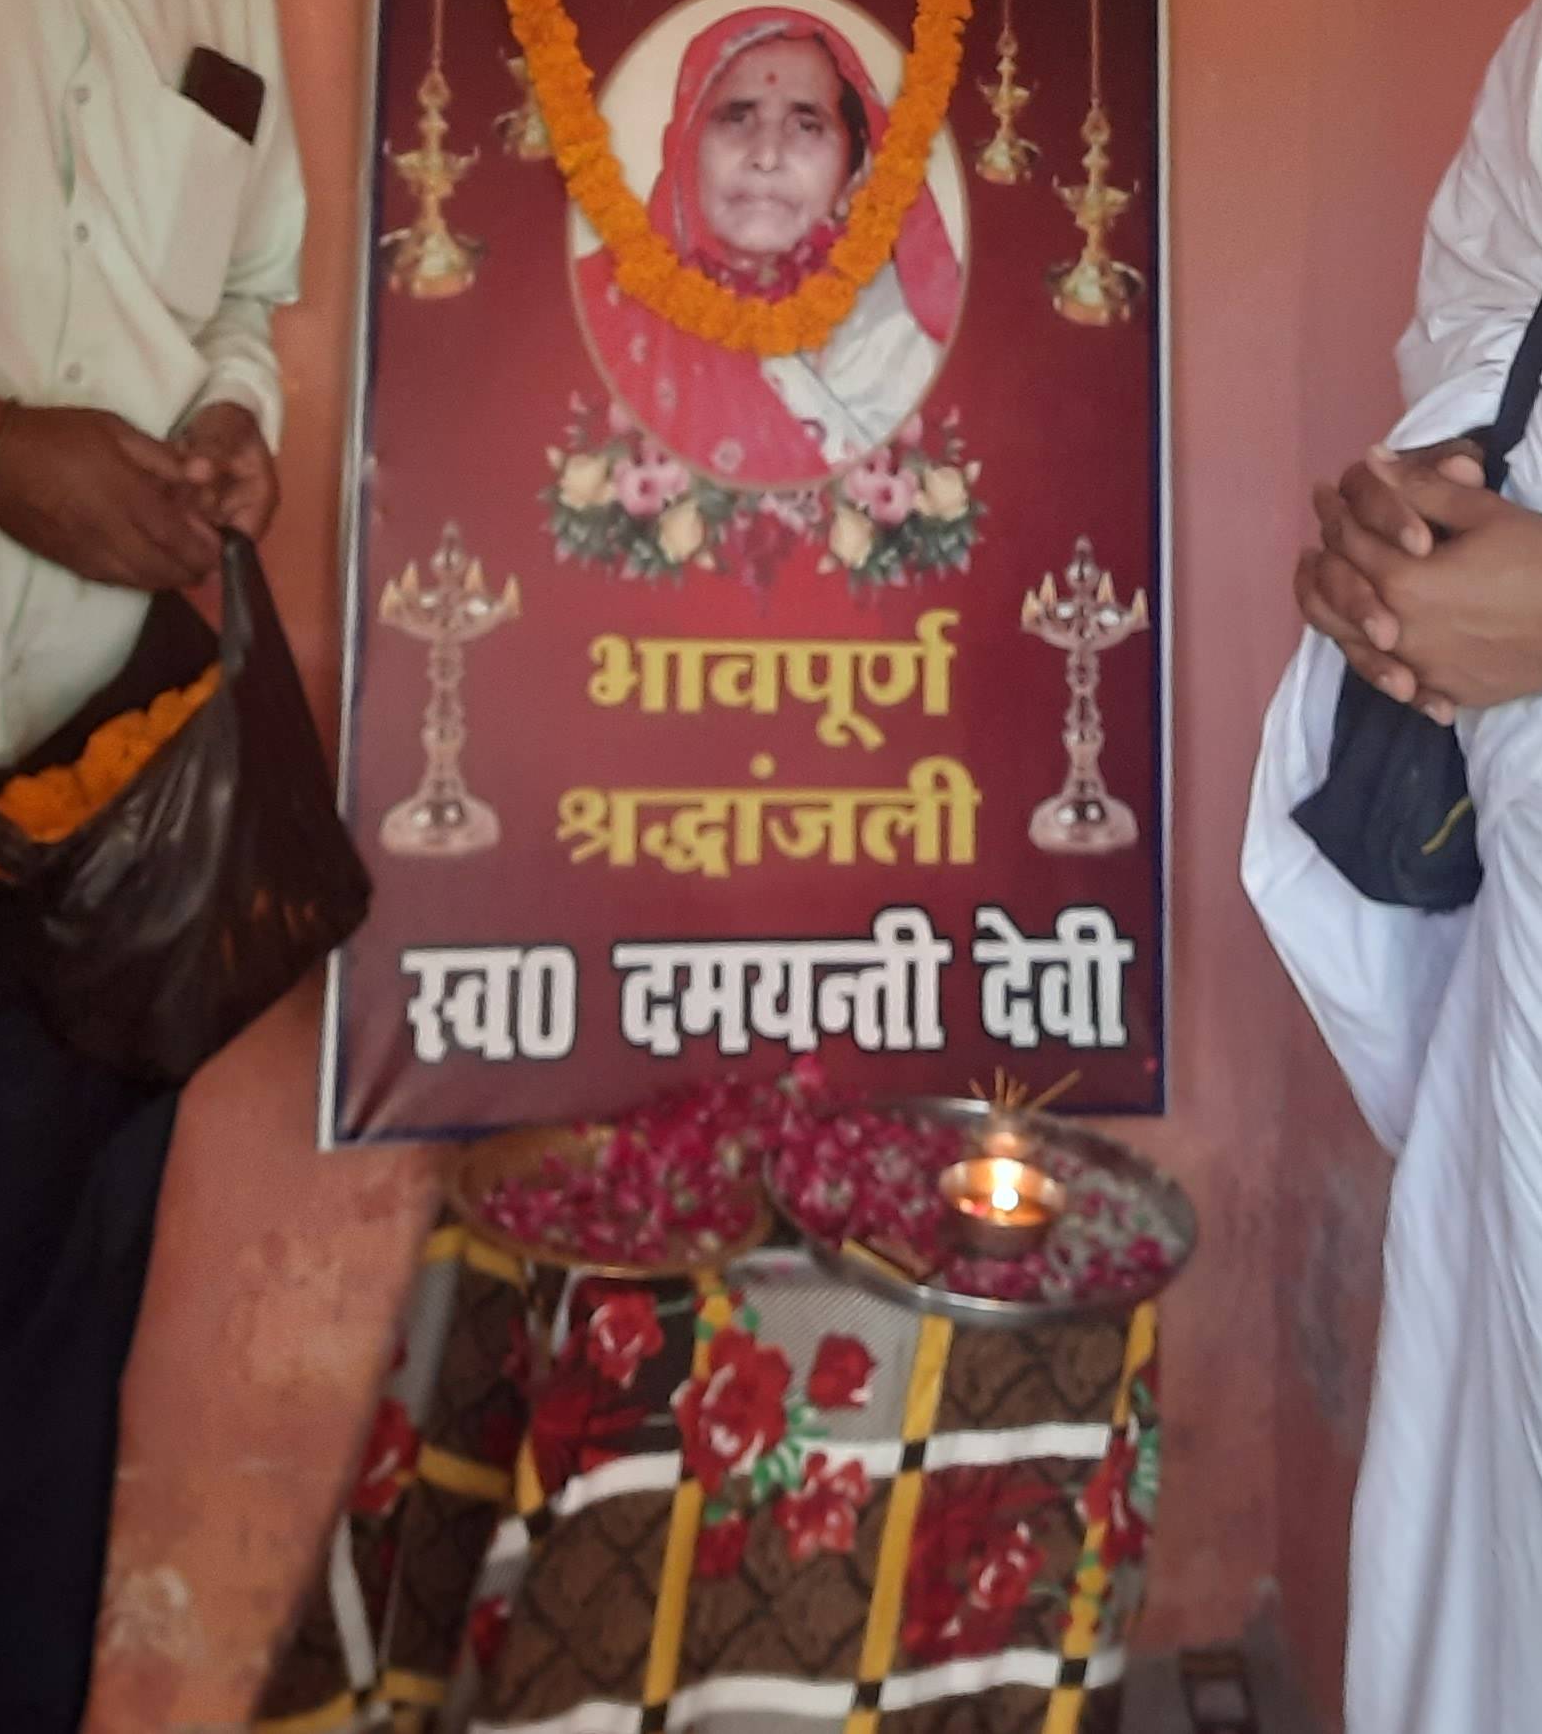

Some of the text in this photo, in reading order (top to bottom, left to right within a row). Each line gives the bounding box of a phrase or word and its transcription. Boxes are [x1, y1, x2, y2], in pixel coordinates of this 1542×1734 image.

[589, 610, 962, 748] भावपूर्ण
[557, 754, 980, 877] श्रद्धांजली
[612, 906, 952, 1057] दमयन्ती
[971, 906, 1135, 1049] देवी
